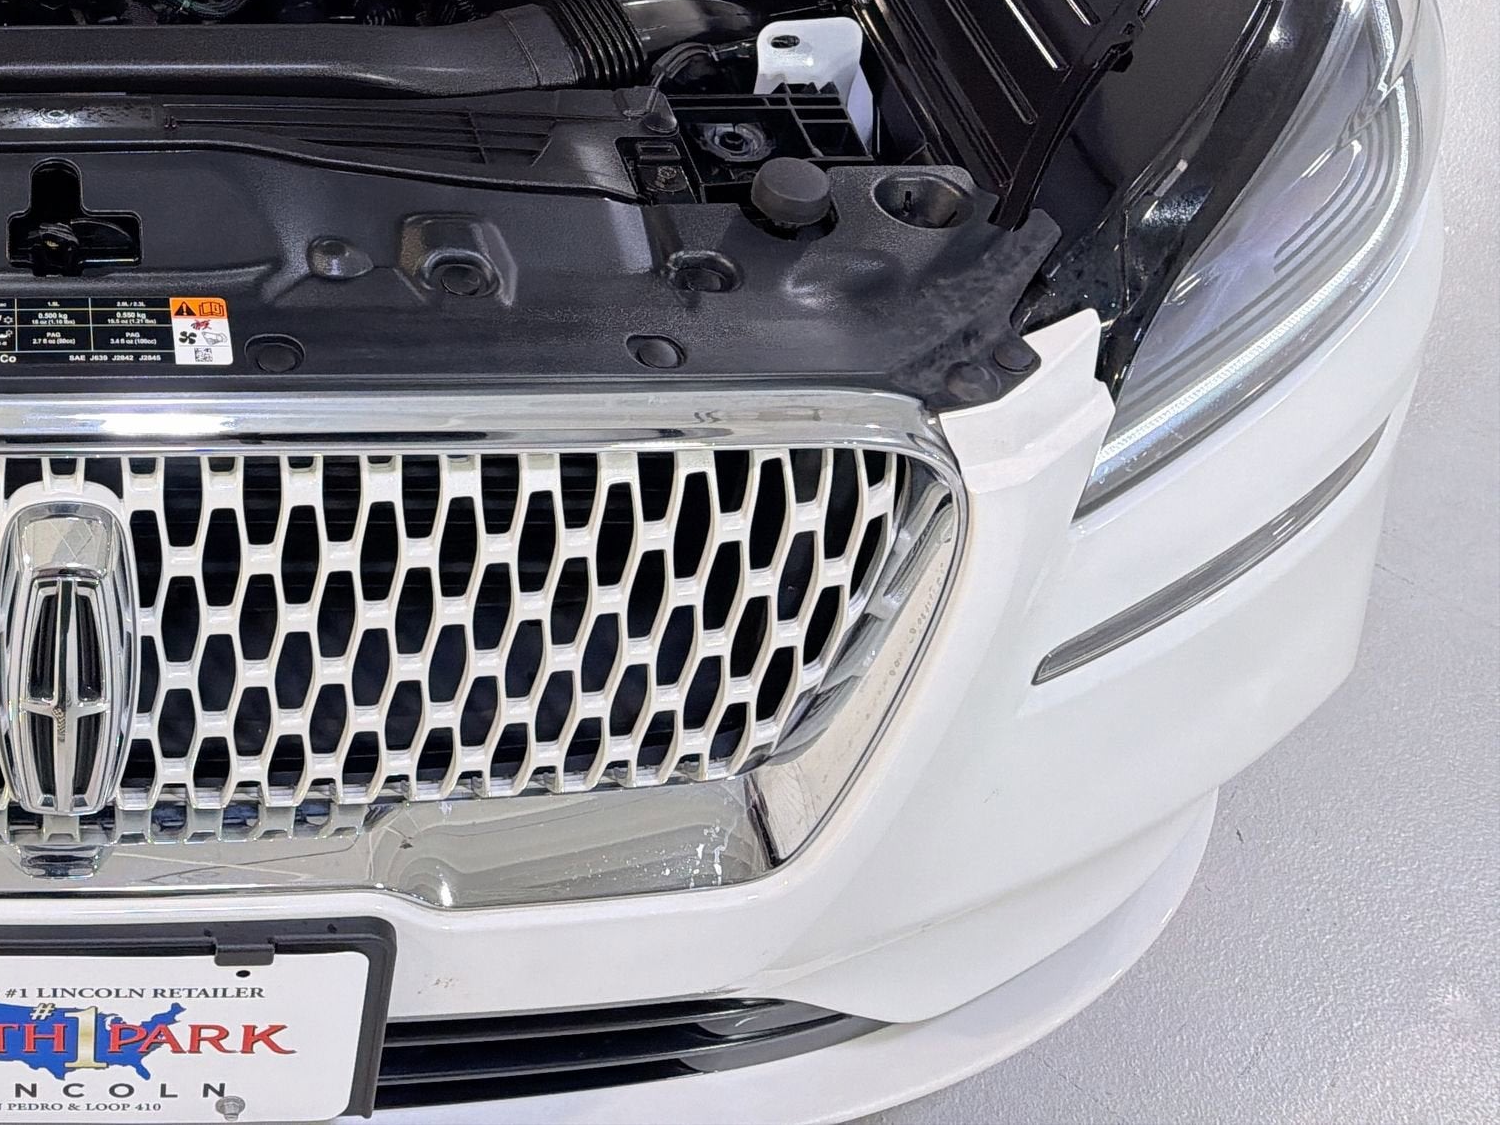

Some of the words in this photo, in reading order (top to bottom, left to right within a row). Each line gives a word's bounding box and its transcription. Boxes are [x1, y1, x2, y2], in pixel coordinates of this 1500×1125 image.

[58, 312, 68, 320] kg
[136, 311, 146, 319] kg
[5, 987, 29, 999] #1
[35, 987, 146, 999] LINCOLN
[152, 987, 265, 999] RETAILER
[108, 1022, 298, 1055] PARK
[7, 1102, 64, 1111] PEDRO
[67, 1102, 81, 1111] &
[86, 1102, 131, 1112] LOOP
[134, 1102, 162, 1111] 410
